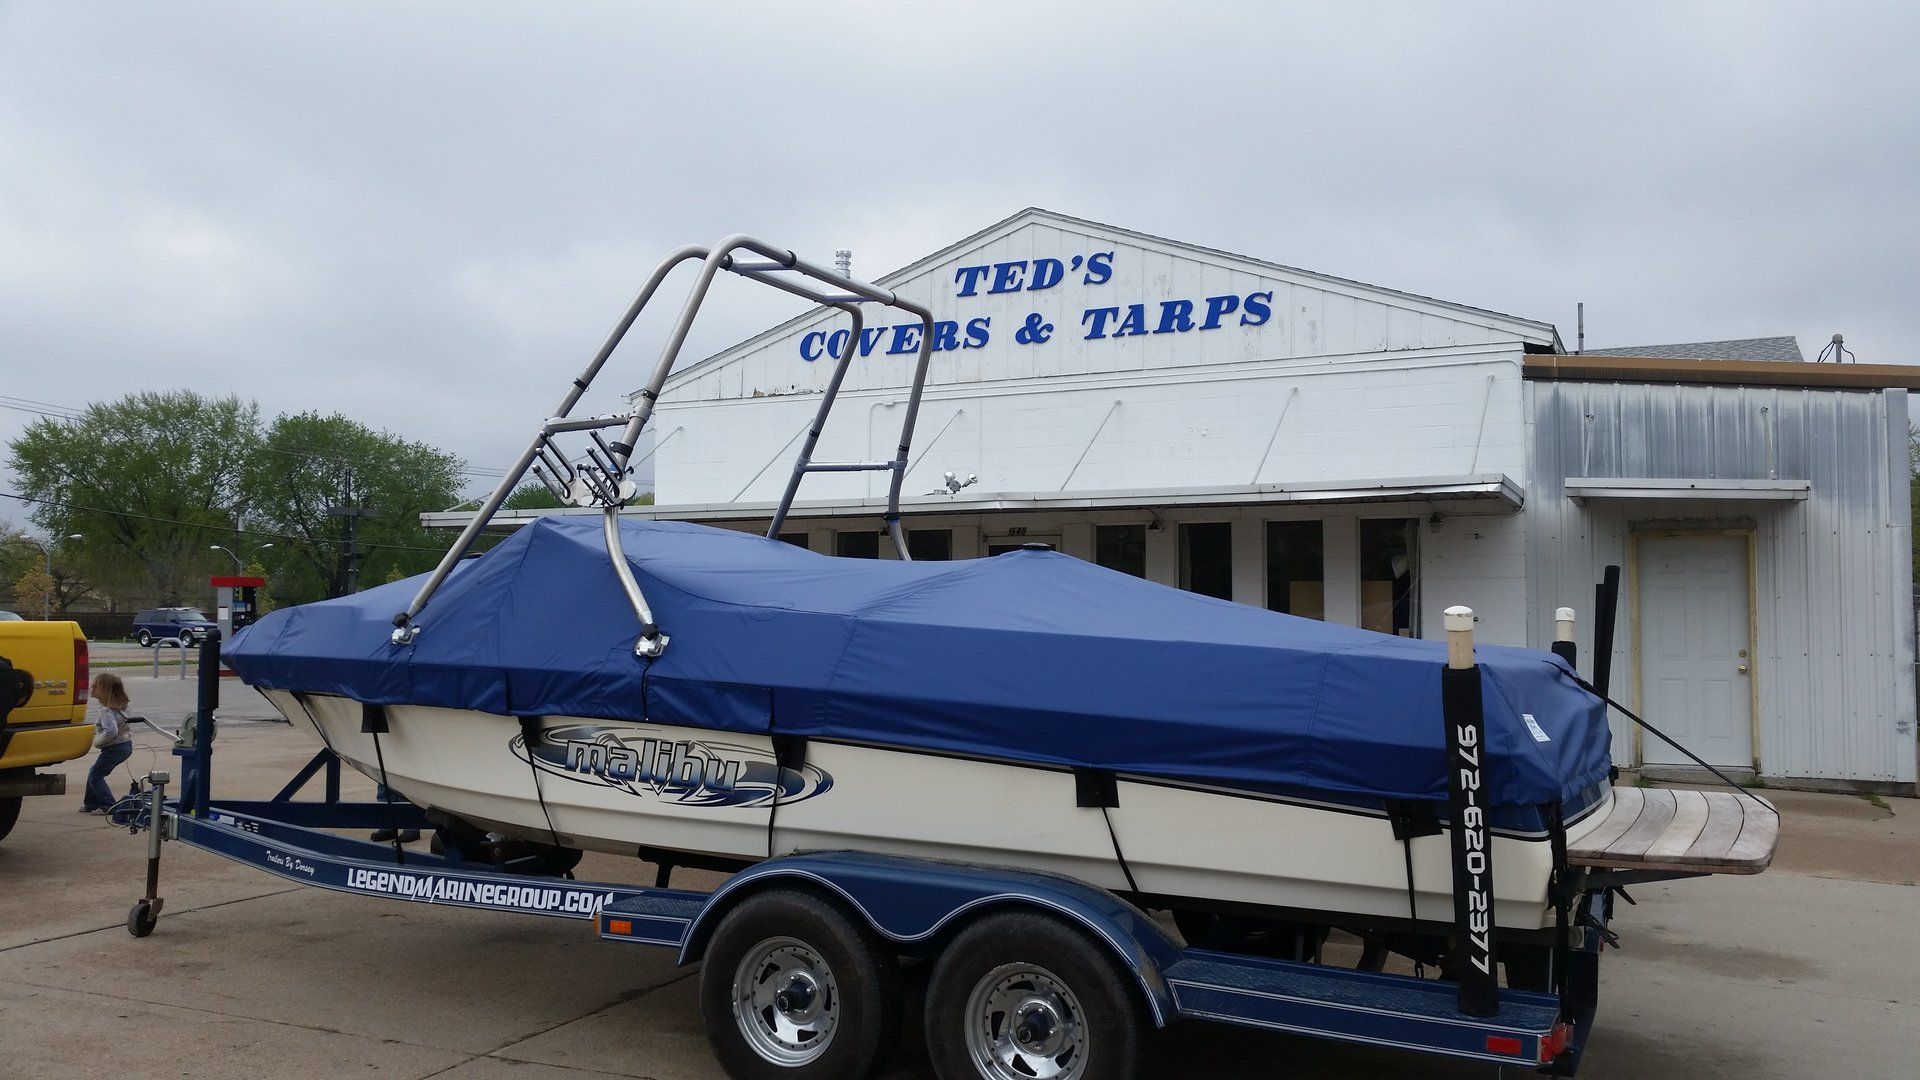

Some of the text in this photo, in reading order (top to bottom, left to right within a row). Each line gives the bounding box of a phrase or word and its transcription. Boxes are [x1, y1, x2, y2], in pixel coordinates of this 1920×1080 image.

[955, 250, 1115, 298] TED'S
[799, 290, 1274, 362] COVERS & TARPS
[563, 739, 741, 795] malibu
[285, 856, 294, 870] By
[1457, 724, 1490, 976] 972-620-2377
